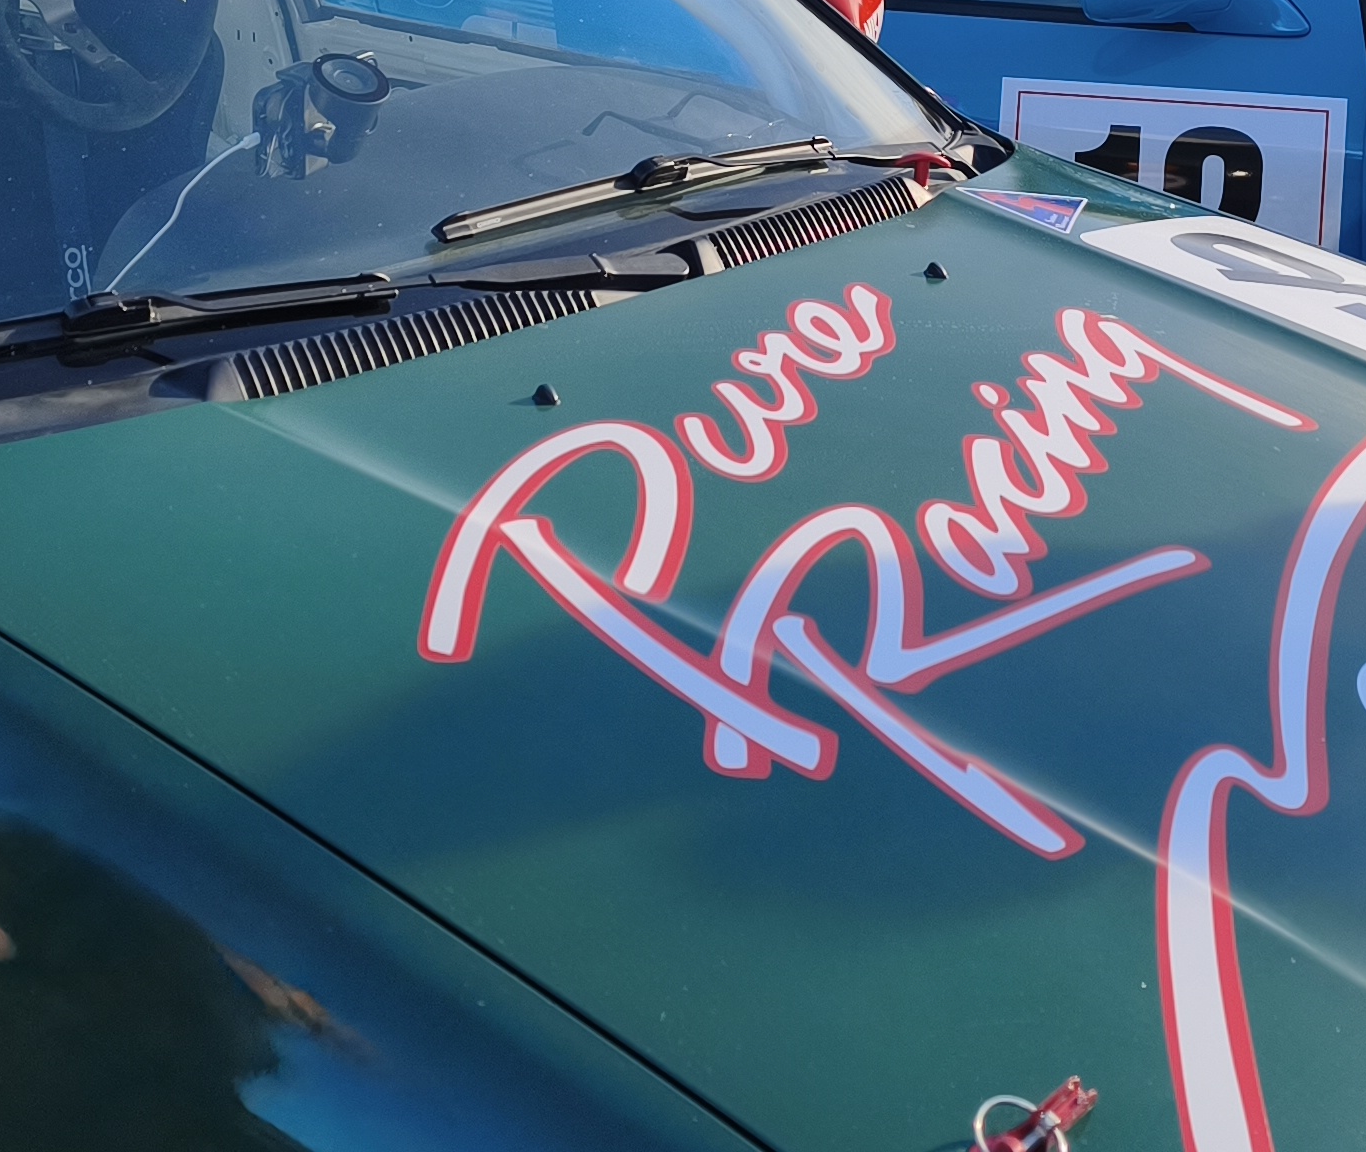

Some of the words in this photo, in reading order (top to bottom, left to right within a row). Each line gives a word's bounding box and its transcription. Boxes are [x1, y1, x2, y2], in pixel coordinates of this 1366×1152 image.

[1074, 124, 1264, 223] 10
[418, 283, 895, 779] Pure
[704, 307, 1319, 861] Racing
